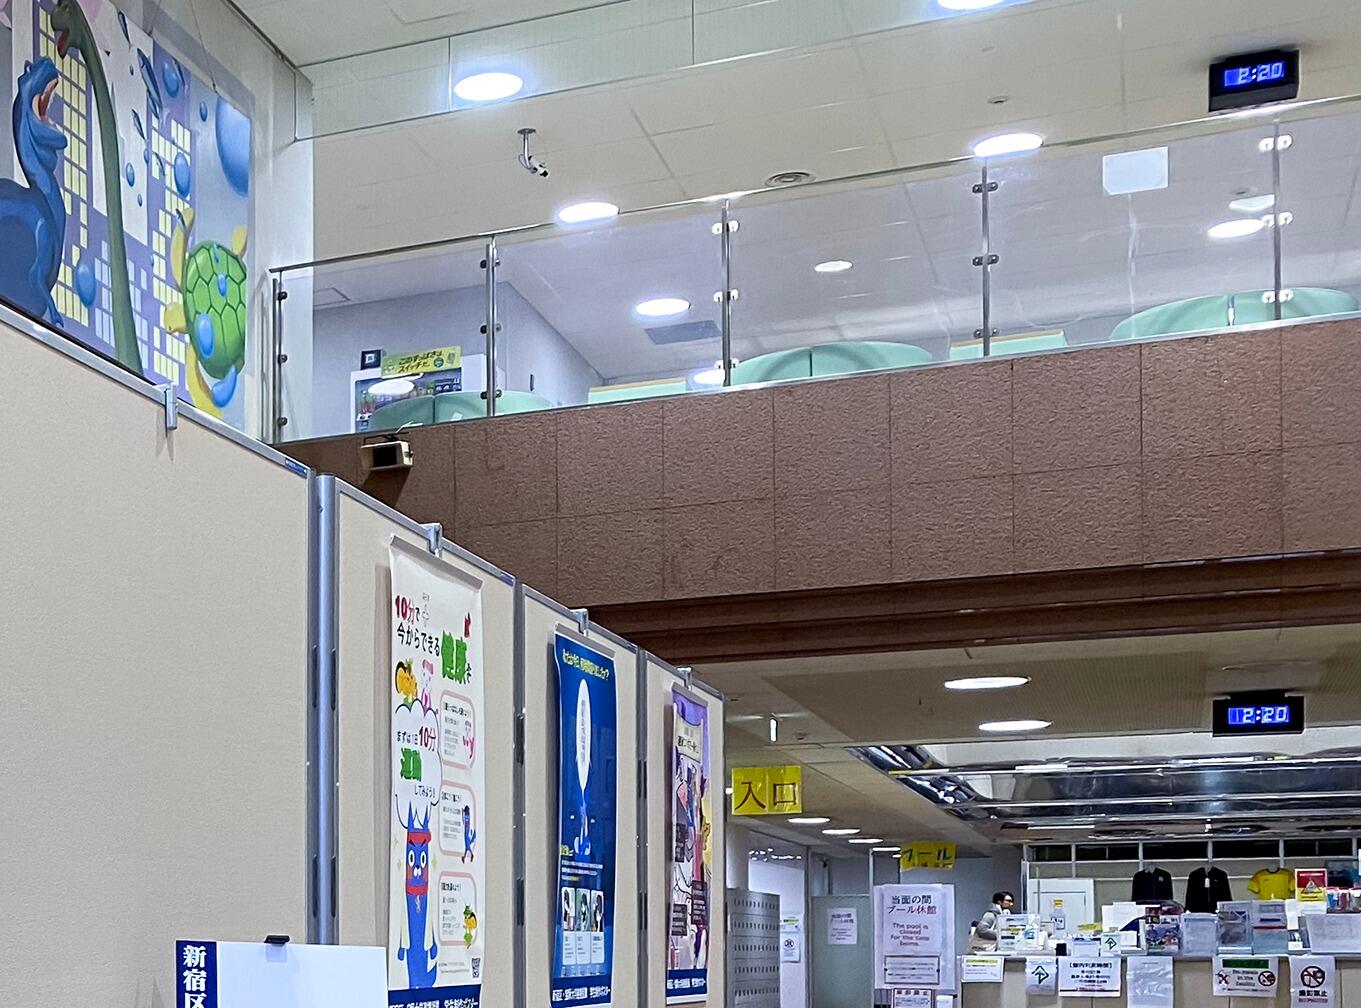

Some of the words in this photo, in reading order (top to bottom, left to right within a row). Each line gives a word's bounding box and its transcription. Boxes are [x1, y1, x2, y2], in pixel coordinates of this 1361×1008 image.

[394, 595, 421, 625] 10分で
[396, 621, 440, 657] 今からできる
[734, 780, 798, 811] 入口
